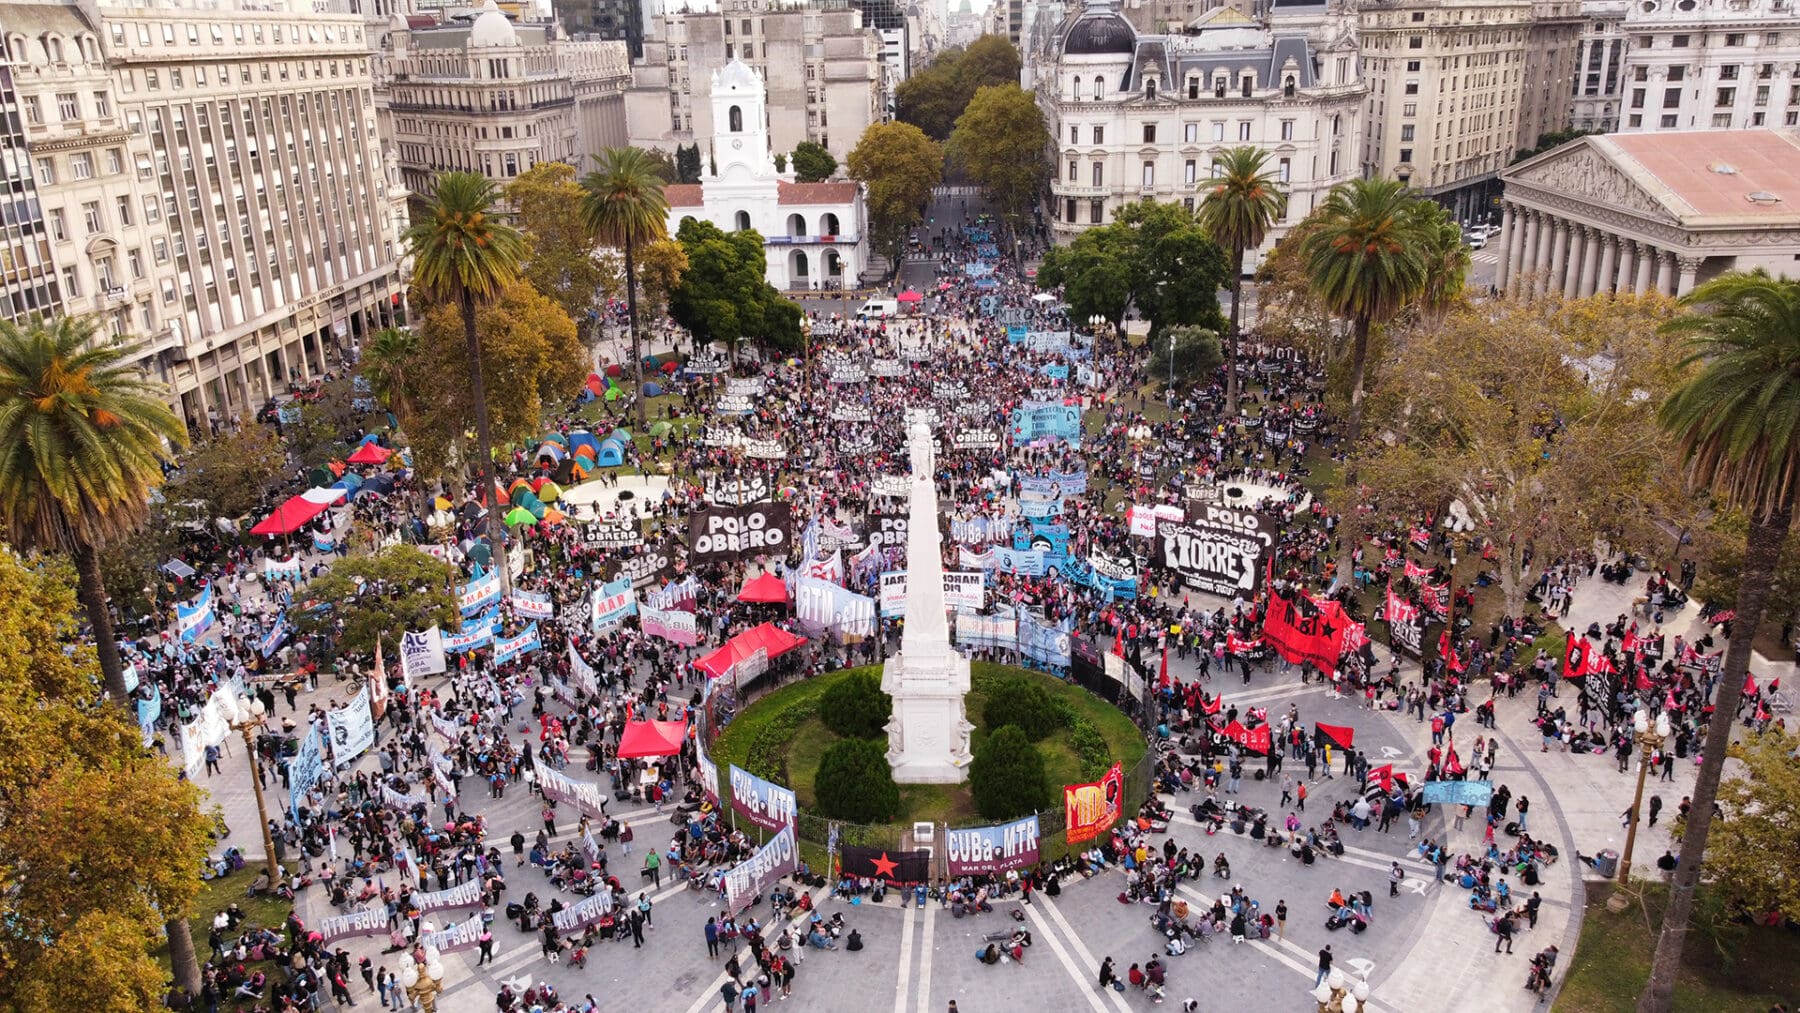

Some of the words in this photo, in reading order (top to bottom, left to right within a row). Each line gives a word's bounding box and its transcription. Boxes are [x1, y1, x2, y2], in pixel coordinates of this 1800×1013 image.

[956, 433, 997, 442] OBRERO
[716, 485, 767, 505] OBRERO
[874, 481, 913, 492] OBRER
[588, 520, 632, 534] POLO
[708, 512, 766, 534] POLO
[1207, 507, 1259, 530] POLO
[587, 531, 638, 542] OBRERO
[696, 528, 783, 554] OBRERO
[614, 556, 668, 580] OBRERO
[621, 552, 658, 570] POLO
[732, 770, 760, 814] CUBa
[768, 788, 794, 828] MTR
[948, 832, 993, 862] CUBa
[1004, 820, 1037, 858] MTR
